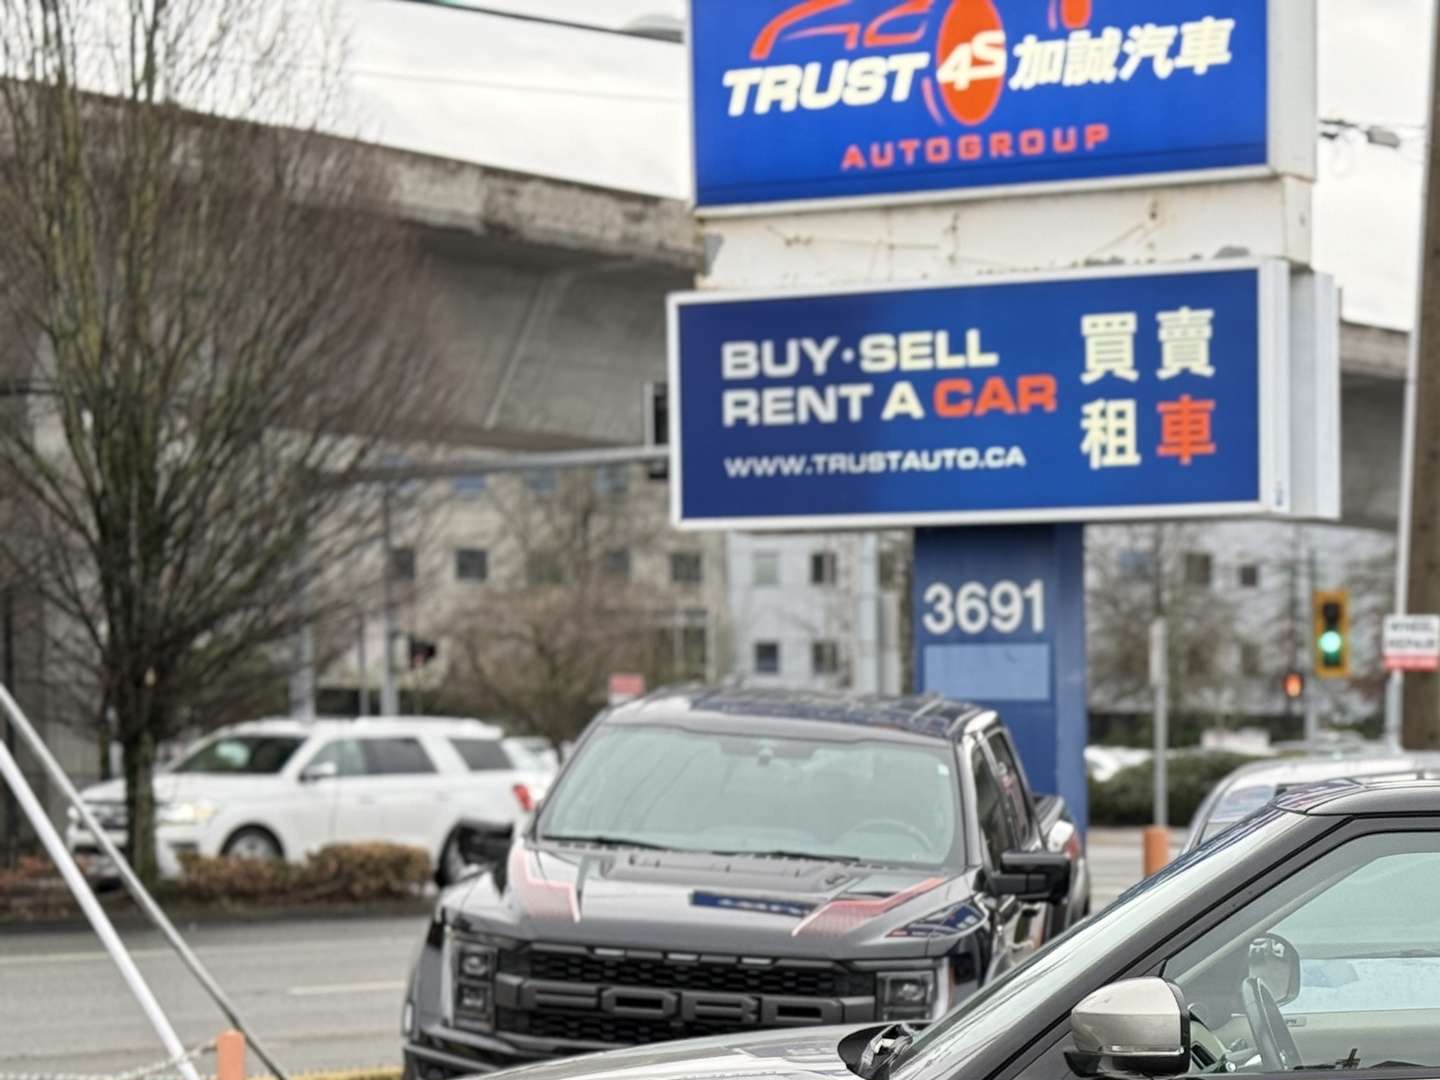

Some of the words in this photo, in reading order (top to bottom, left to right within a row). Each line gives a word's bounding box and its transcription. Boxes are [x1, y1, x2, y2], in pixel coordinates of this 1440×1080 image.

[722, 52, 930, 117] TRUST
[936, 29, 1008, 92] 4S
[1008, 16, 1236, 91] 加誠汽車
[841, 123, 1111, 171] AUTOGROUP
[721, 383, 874, 427] RENT
[881, 381, 926, 421] A
[932, 374, 1058, 419] CAR
[724, 446, 1027, 478] WWW.TRUSTAUTO.CA
[922, 578, 1046, 635] 3691
[524, 979, 846, 1028] FORD
